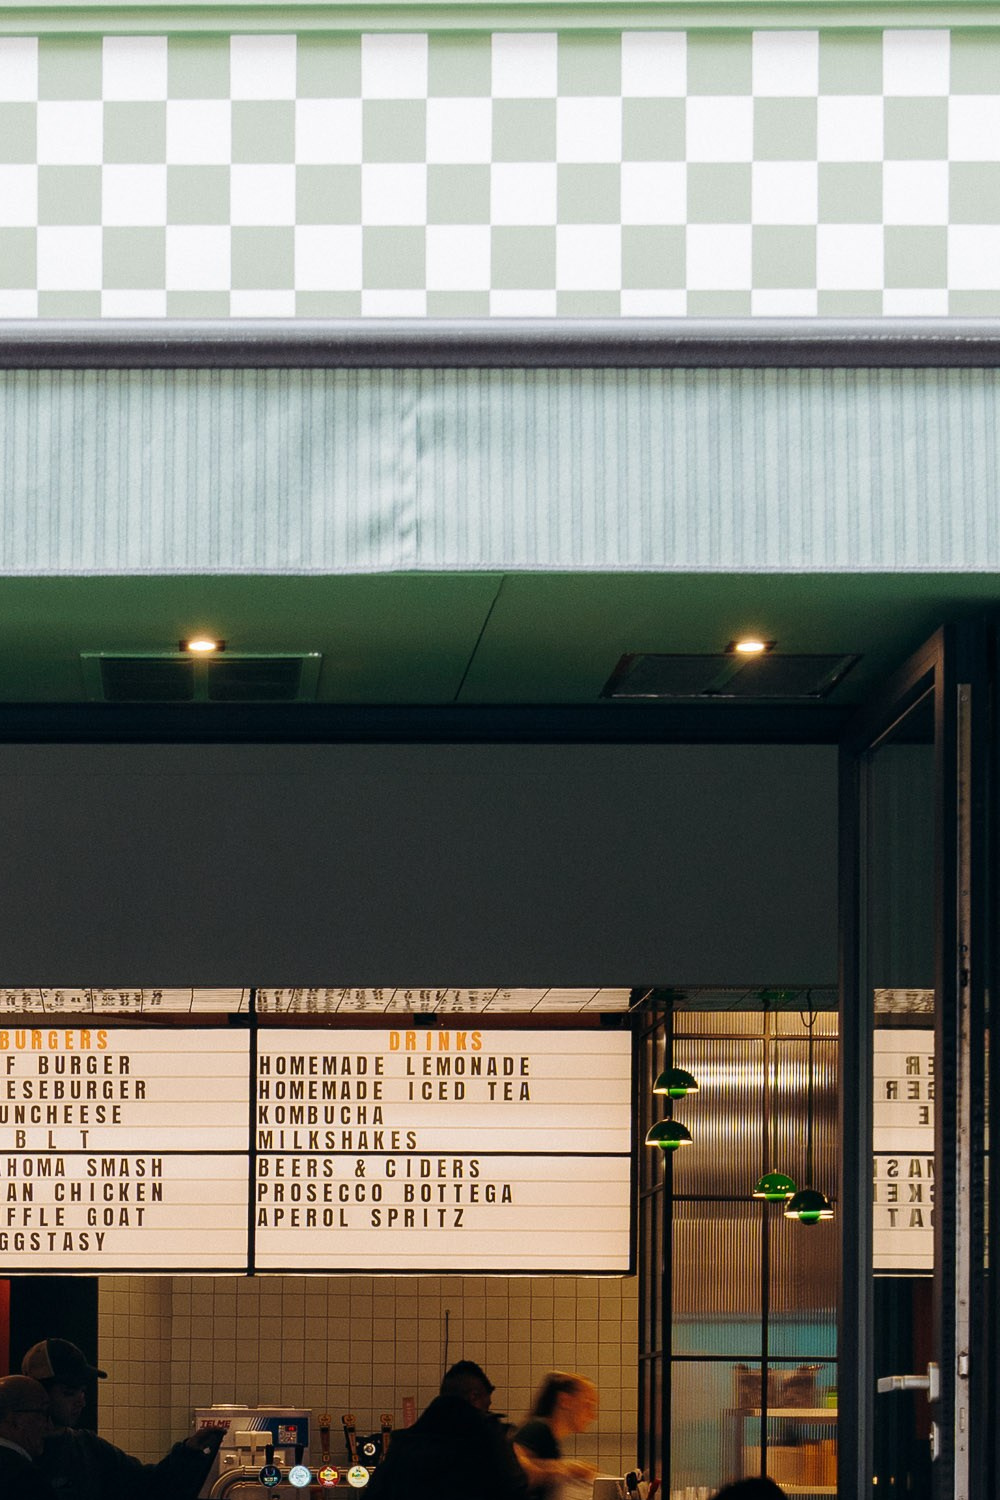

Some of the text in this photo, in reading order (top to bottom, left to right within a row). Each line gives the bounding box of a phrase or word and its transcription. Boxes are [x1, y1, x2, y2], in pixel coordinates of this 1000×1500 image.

[0, 1029, 108, 1050] BURGERS
[389, 1030, 482, 1051] DRINKS
[38, 1055, 130, 1075] BURGER
[259, 1055, 529, 1076] HOMEMADE LEMONADE
[259, 1080, 530, 1101] HOMEMADE ICED TEA
[258, 1105, 383, 1125] KOMBUCHA
[258, 1130, 417, 1150] MILKSHAKES
[87, 1158, 162, 1178] SMASH
[258, 1158, 480, 1178] BEERS & CIDERS
[54, 1182, 163, 1202] CHICKEN
[257, 1182, 512, 1204] PROSECCO BOTTEGA
[87, 1207, 145, 1227] GOAT
[257, 1207, 464, 1228] APEROL SPRITZ
